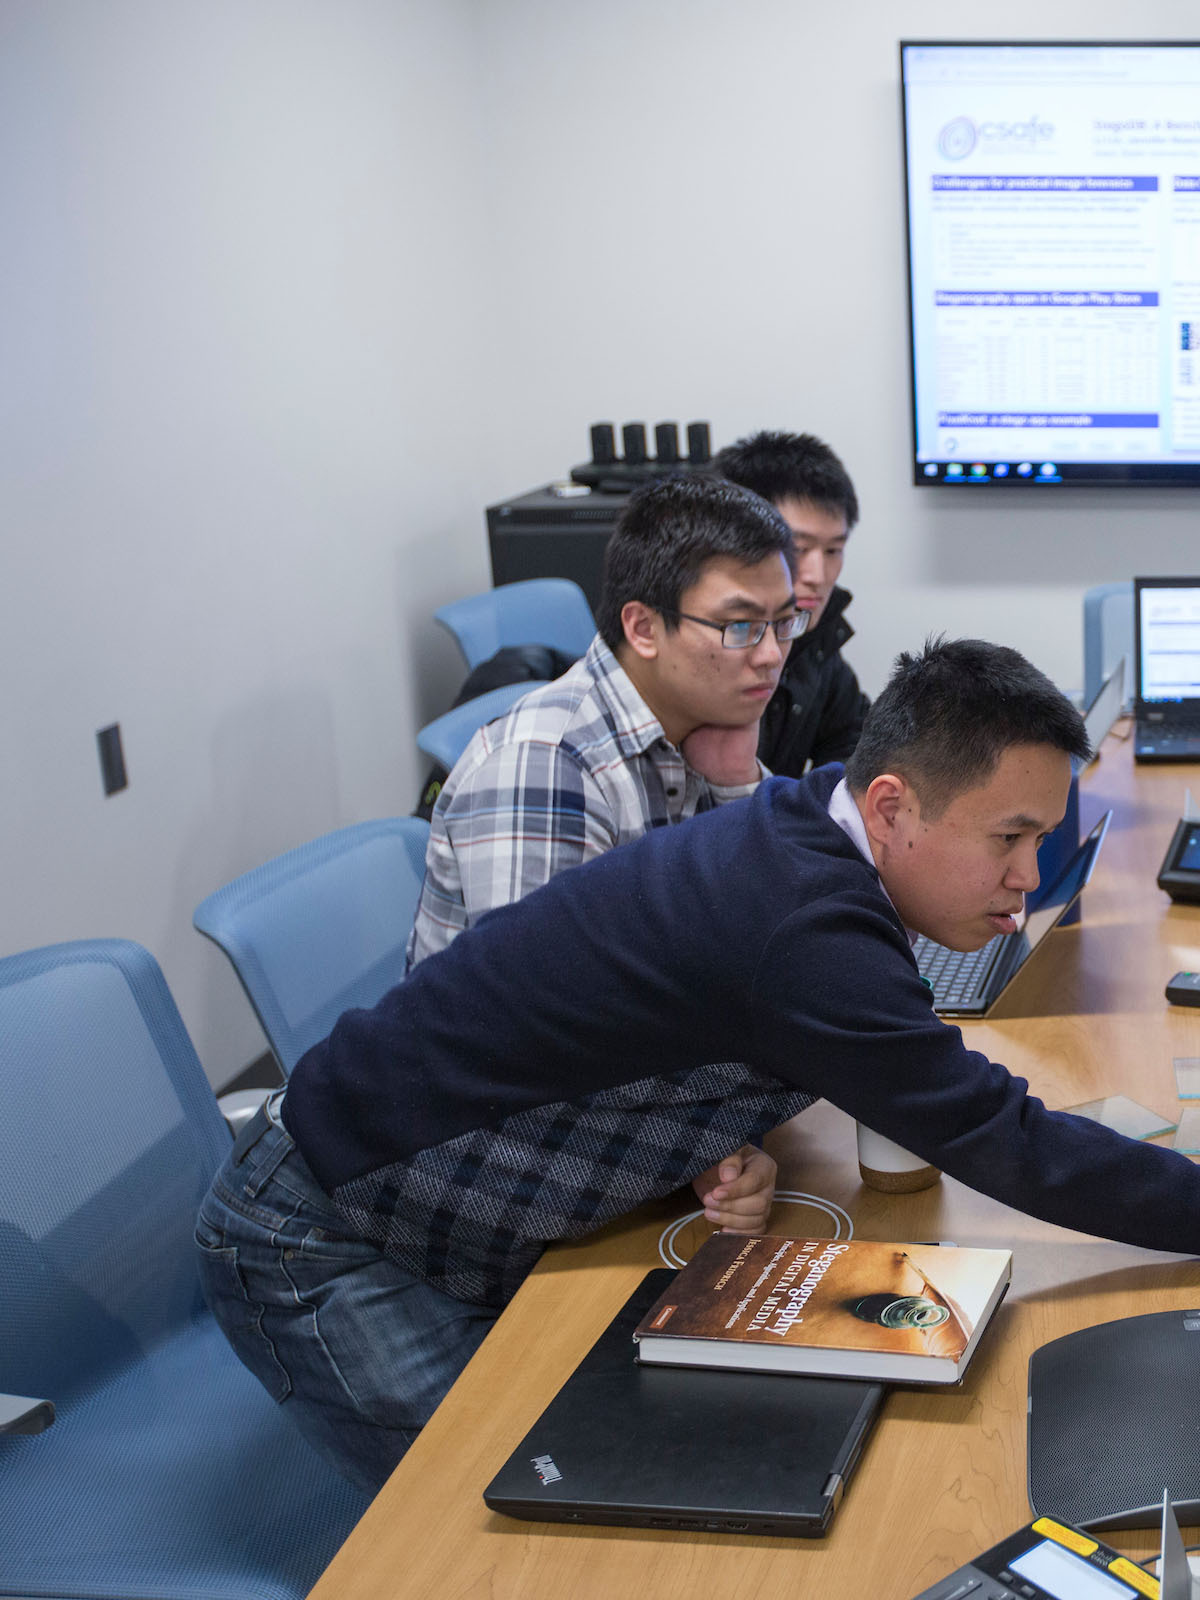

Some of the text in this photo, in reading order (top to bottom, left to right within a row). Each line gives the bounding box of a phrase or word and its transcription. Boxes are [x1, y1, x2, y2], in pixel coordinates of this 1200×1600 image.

[978, 116, 1055, 144] csafe
[713, 1260, 746, 1291] FRIDRICH
[746, 1241, 820, 1332] IN DIGITAL MEDIA
[760, 1242, 850, 1337] Steganography
